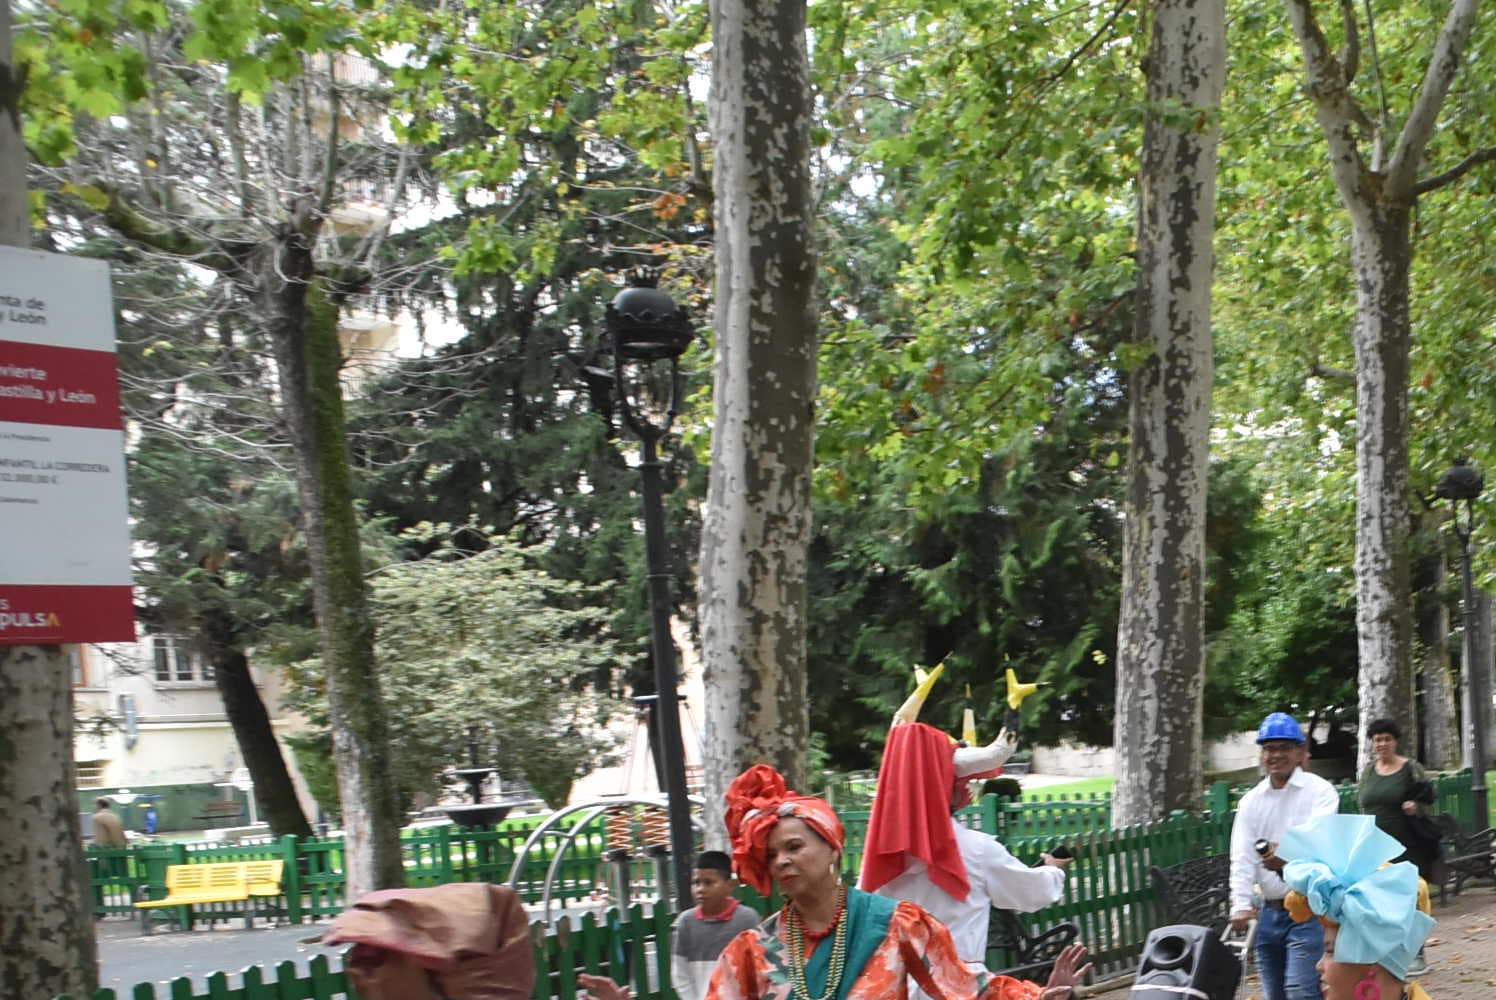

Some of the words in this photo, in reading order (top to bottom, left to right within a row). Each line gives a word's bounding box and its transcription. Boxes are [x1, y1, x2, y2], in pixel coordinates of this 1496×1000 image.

[25, 297, 45, 311] de
[9, 309, 47, 326] León
[45, 390, 56, 404] y
[59, 388, 96, 405] León
